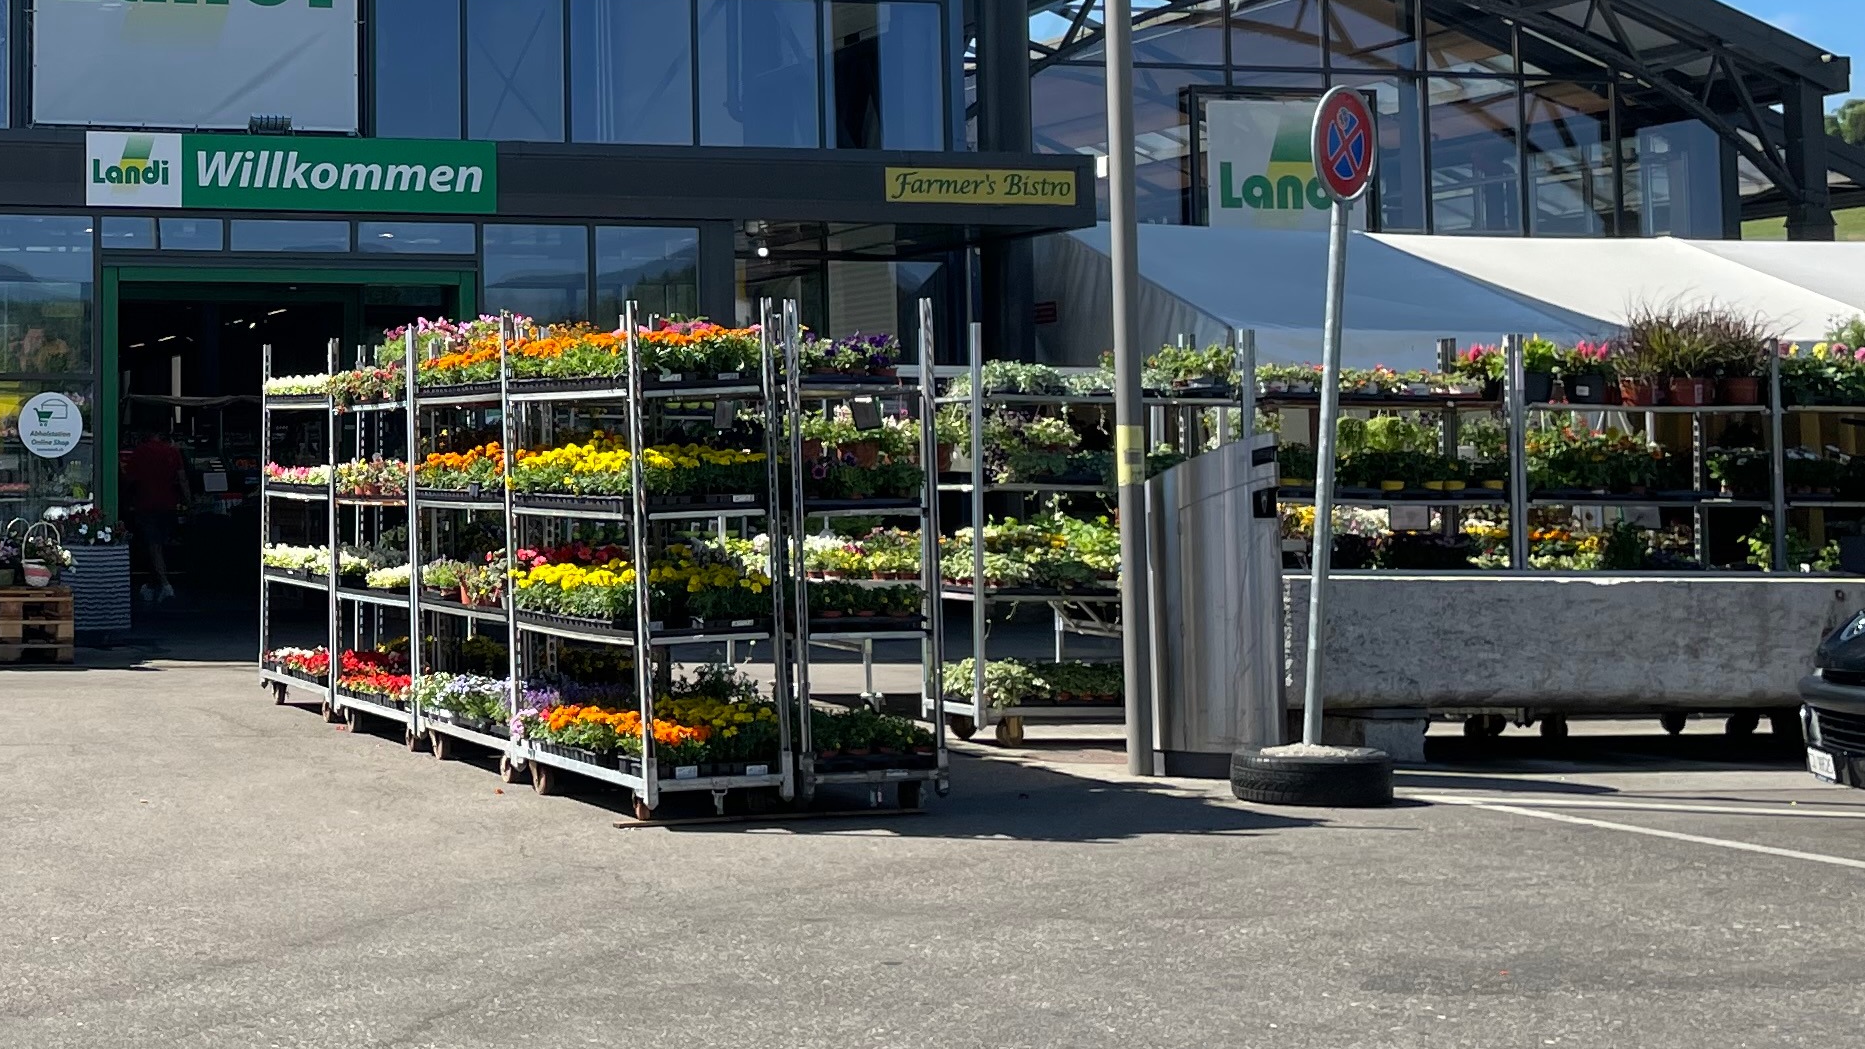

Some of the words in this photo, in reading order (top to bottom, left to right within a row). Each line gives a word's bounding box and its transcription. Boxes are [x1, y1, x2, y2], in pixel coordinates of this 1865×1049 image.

[92, 158, 170, 185] Landi
[196, 150, 483, 193] Willkommen
[891, 171, 996, 199] Farmer's
[1003, 173, 1071, 197] Bistro
[1219, 161, 1332, 210] Lan
